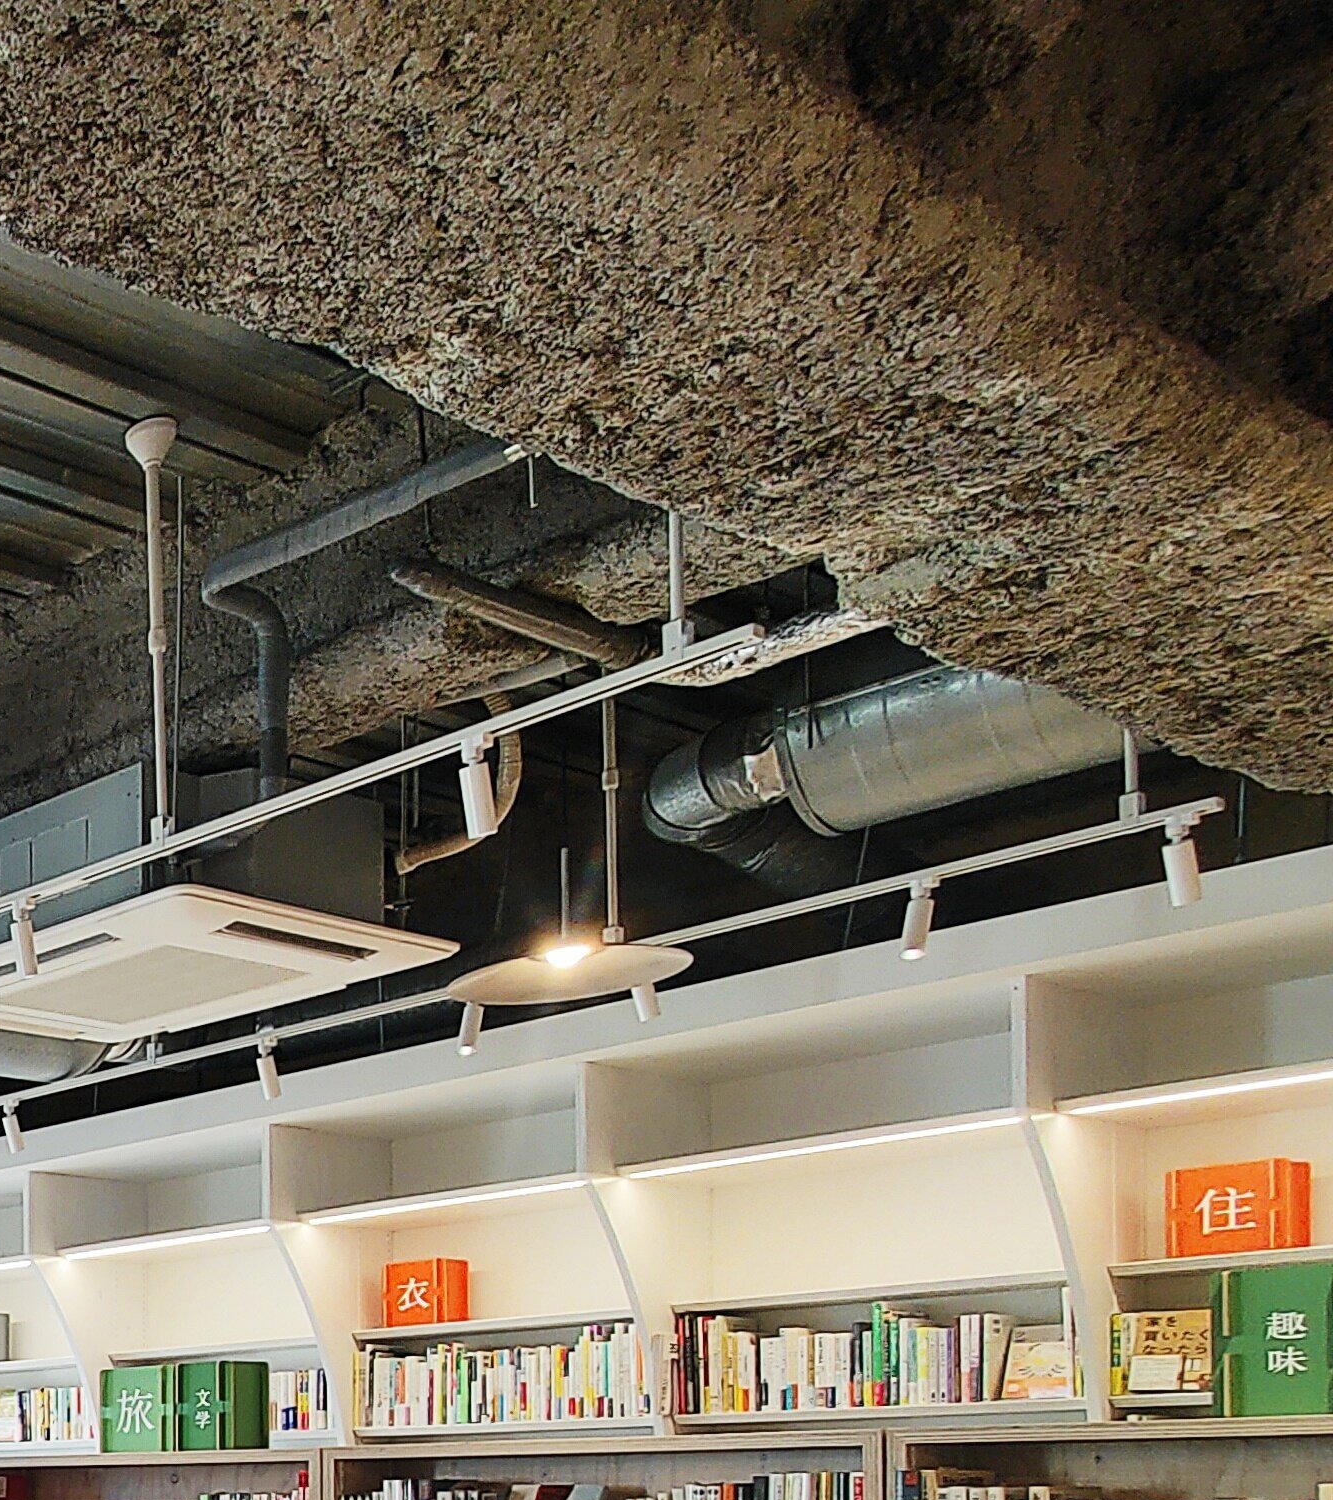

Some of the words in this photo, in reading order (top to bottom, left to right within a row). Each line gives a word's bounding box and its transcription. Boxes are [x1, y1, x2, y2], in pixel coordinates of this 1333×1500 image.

[1194, 1187, 1257, 1235] 住
[396, 1276, 431, 1312] 衣
[1142, 1343, 1208, 1355] なったら
[1143, 1330, 1208, 1342] 買いたく
[1265, 1311, 1309, 1376] 趣味
[116, 1388, 156, 1433] 旅
[195, 1388, 211, 1429] 文学
